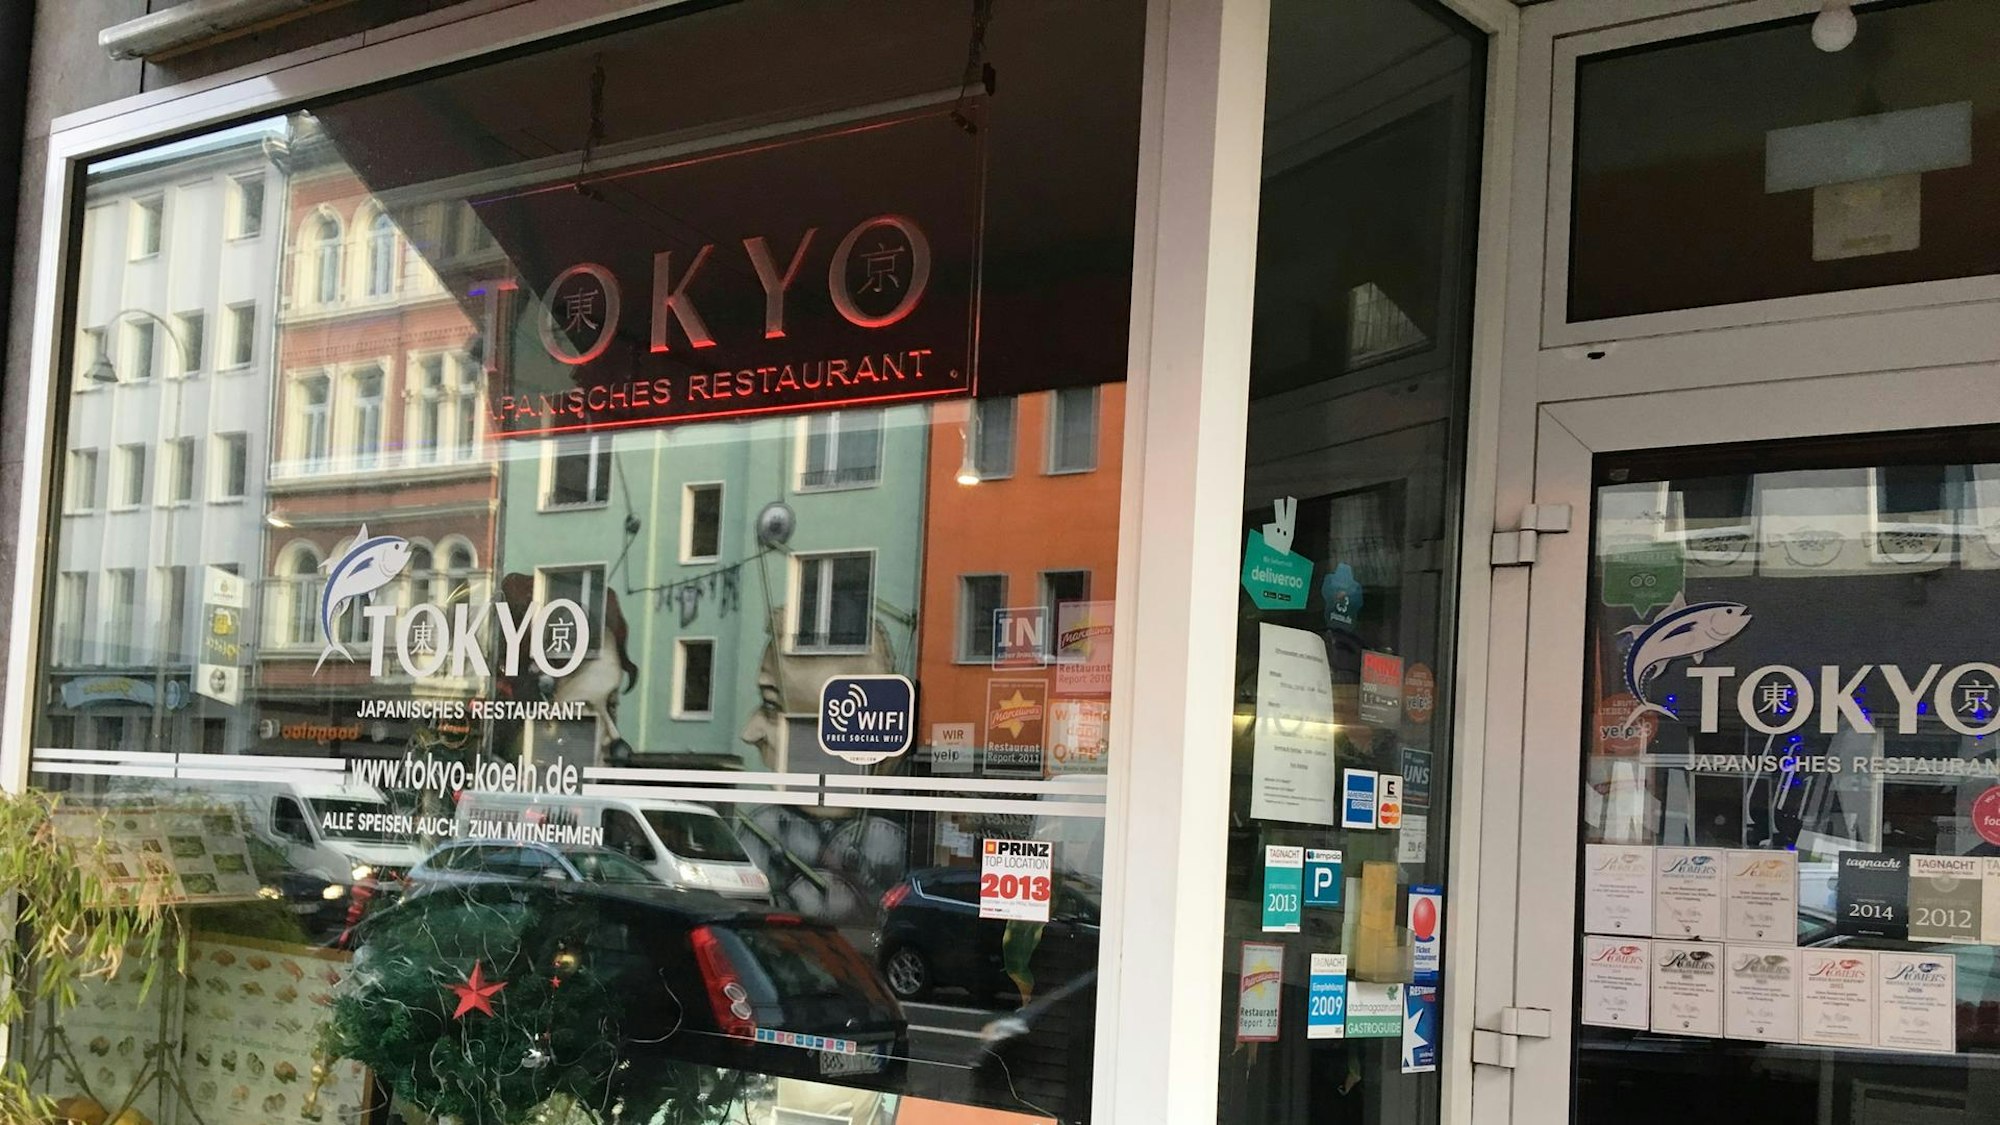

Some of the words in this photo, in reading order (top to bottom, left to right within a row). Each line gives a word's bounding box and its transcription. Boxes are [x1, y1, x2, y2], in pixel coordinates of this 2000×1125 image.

[857, 243, 906, 296] 京
[472, 215, 931, 372] TOKYO
[474, 377, 672, 421] APANISCHES
[688, 350, 932, 400] RESTAURANT
[1251, 566, 1304, 589] deliveroo
[364, 598, 590, 677] TOKYO
[410, 621, 435, 655] 東
[546, 618, 574, 654] 京
[998, 617, 1044, 647] IN
[1059, 663, 1111, 673] Restaurant
[1059, 675, 1088, 685] Report
[1686, 661, 2000, 736] TOKYO
[1758, 681, 1793, 715] 東
[1957, 680, 1995, 715] 京
[357, 700, 465, 719] JAPANISCHES
[472, 701, 586, 720] RESTAURANT
[828, 699, 856, 717] SO
[857, 711, 904, 730] WIFI
[826, 734, 846, 742] FREE
[849, 734, 880, 742] SOCIAL
[883, 735, 903, 743] WIFI
[942, 729, 964, 740] WIR
[934, 749, 960, 762] yelp
[988, 742, 1041, 752] Restaurant
[987, 752, 1016, 763] Report
[1018, 753, 1041, 764] 2011
[1684, 753, 1842, 774] JAPANISCHES
[1853, 756, 2000, 776] RESTAURAN
[351, 752, 578, 798] www.tokyo-koeln.de
[1403, 765, 1430, 784] UNS
[322, 811, 354, 831] ALLE
[357, 812, 413, 835] SPEISEN
[416, 818, 459, 837] AUCH
[469, 820, 502, 840] ZUM
[507, 822, 604, 847] MITNEHMEN
[998, 842, 1049, 857] PRINZ
[1269, 848, 1300, 859] TAGNACHT
[985, 856, 1003, 867] TOP
[1004, 858, 1049, 869] LOCATION
[1846, 857, 1901, 869] tagnacht
[1916, 858, 1976, 870] TAGNACHT
[981, 873, 1050, 901] 2013
[1314, 867, 1333, 898] P
[1267, 893, 1298, 912] 2013
[1849, 903, 1895, 921] 2014
[1915, 907, 1972, 929] 2012
[1240, 1007, 1278, 1017] Restaurant
[1311, 996, 1344, 1016] 2009
[1240, 1018, 1263, 1030] Report
[1348, 1022, 1401, 1034] GASTROGUIDE
